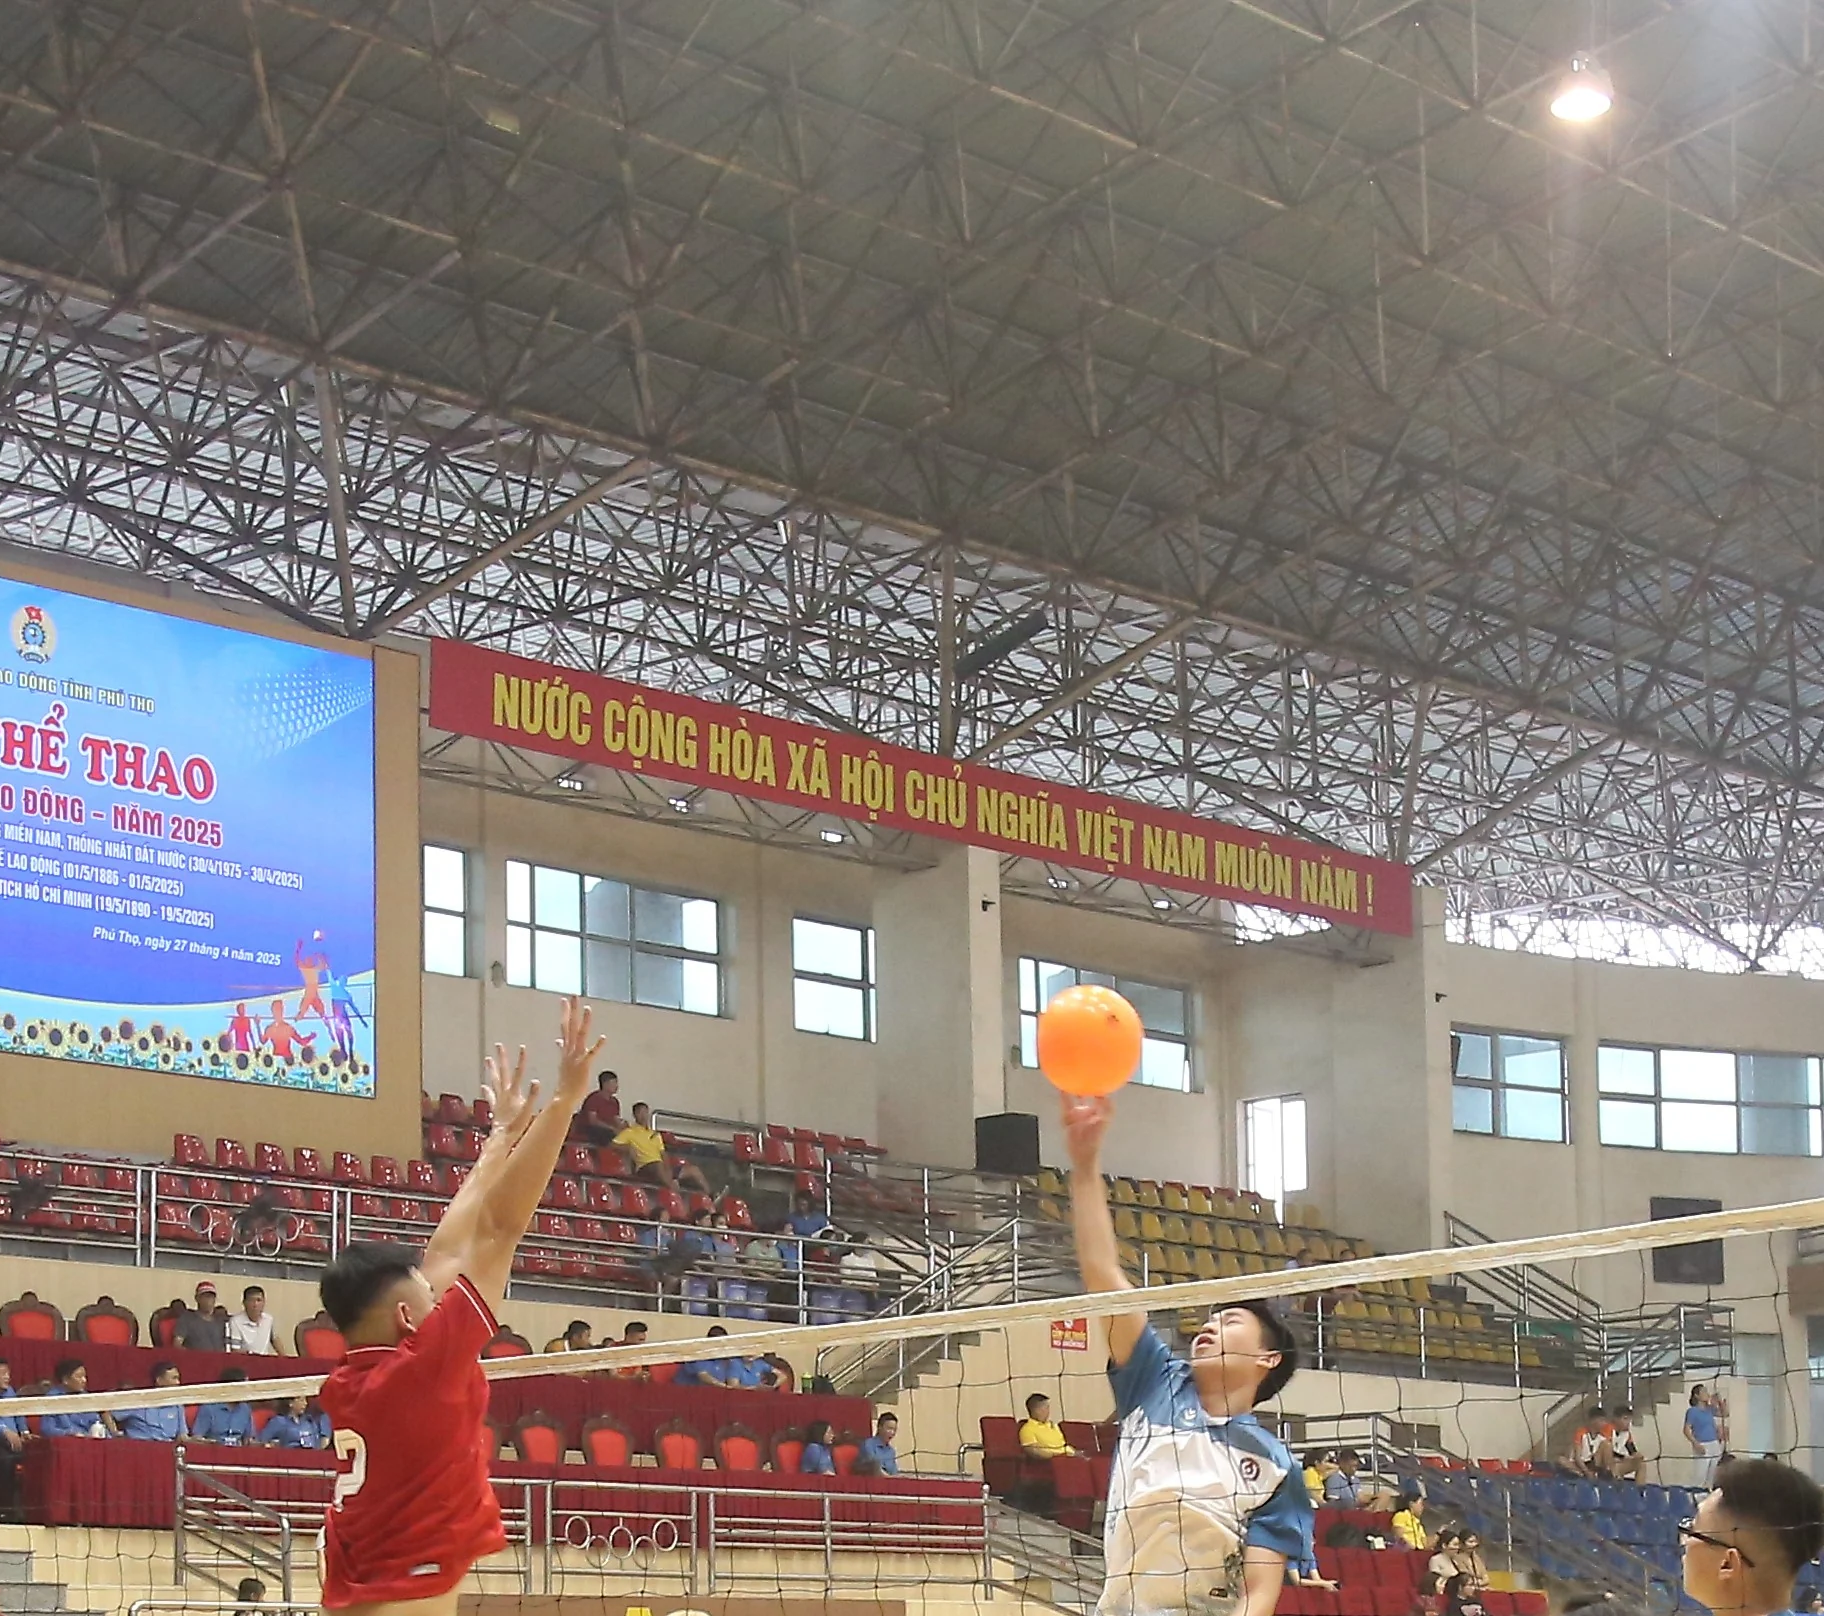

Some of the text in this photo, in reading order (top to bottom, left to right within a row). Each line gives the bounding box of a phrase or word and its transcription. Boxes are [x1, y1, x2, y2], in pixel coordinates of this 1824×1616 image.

[18, 670, 57, 695] ĐỘNG
[97, 687, 126, 708] PHÚ
[129, 693, 156, 715] THỌ
[81, 737, 216, 801] THAO
[493, 672, 1374, 916] NƯỚC CỘNG HÒA XÃ HỘI CHỦ NGHĨA VIỆT NAM MUÔN NĂM !
[22, 788, 84, 826] ĐỘNG
[111, 801, 164, 839] NĂM
[169, 816, 223, 849] 2025
[7, 853, 28, 871] LAO
[30, 855, 61, 878] ĐỘNG
[63, 861, 120, 887] (01/5/1886
[129, 874, 184, 898] 01/5/2025)
[35, 829, 64, 851] NAM,
[67, 831, 102, 857] THỐNG
[157, 846, 186, 870] NƯỚC
[188, 854, 243, 880] (30/4/1975
[251, 867, 303, 891] 30/4/2025)
[24, 879, 40, 901] HỒ
[63, 889, 93, 909] MINH
[95, 894, 151, 920] (19/5/1890
[160, 907, 215, 930] 19/5/2025)
[93, 926, 281, 966] Phú Thọ, ngày 27 tháng 4 năm 2025
